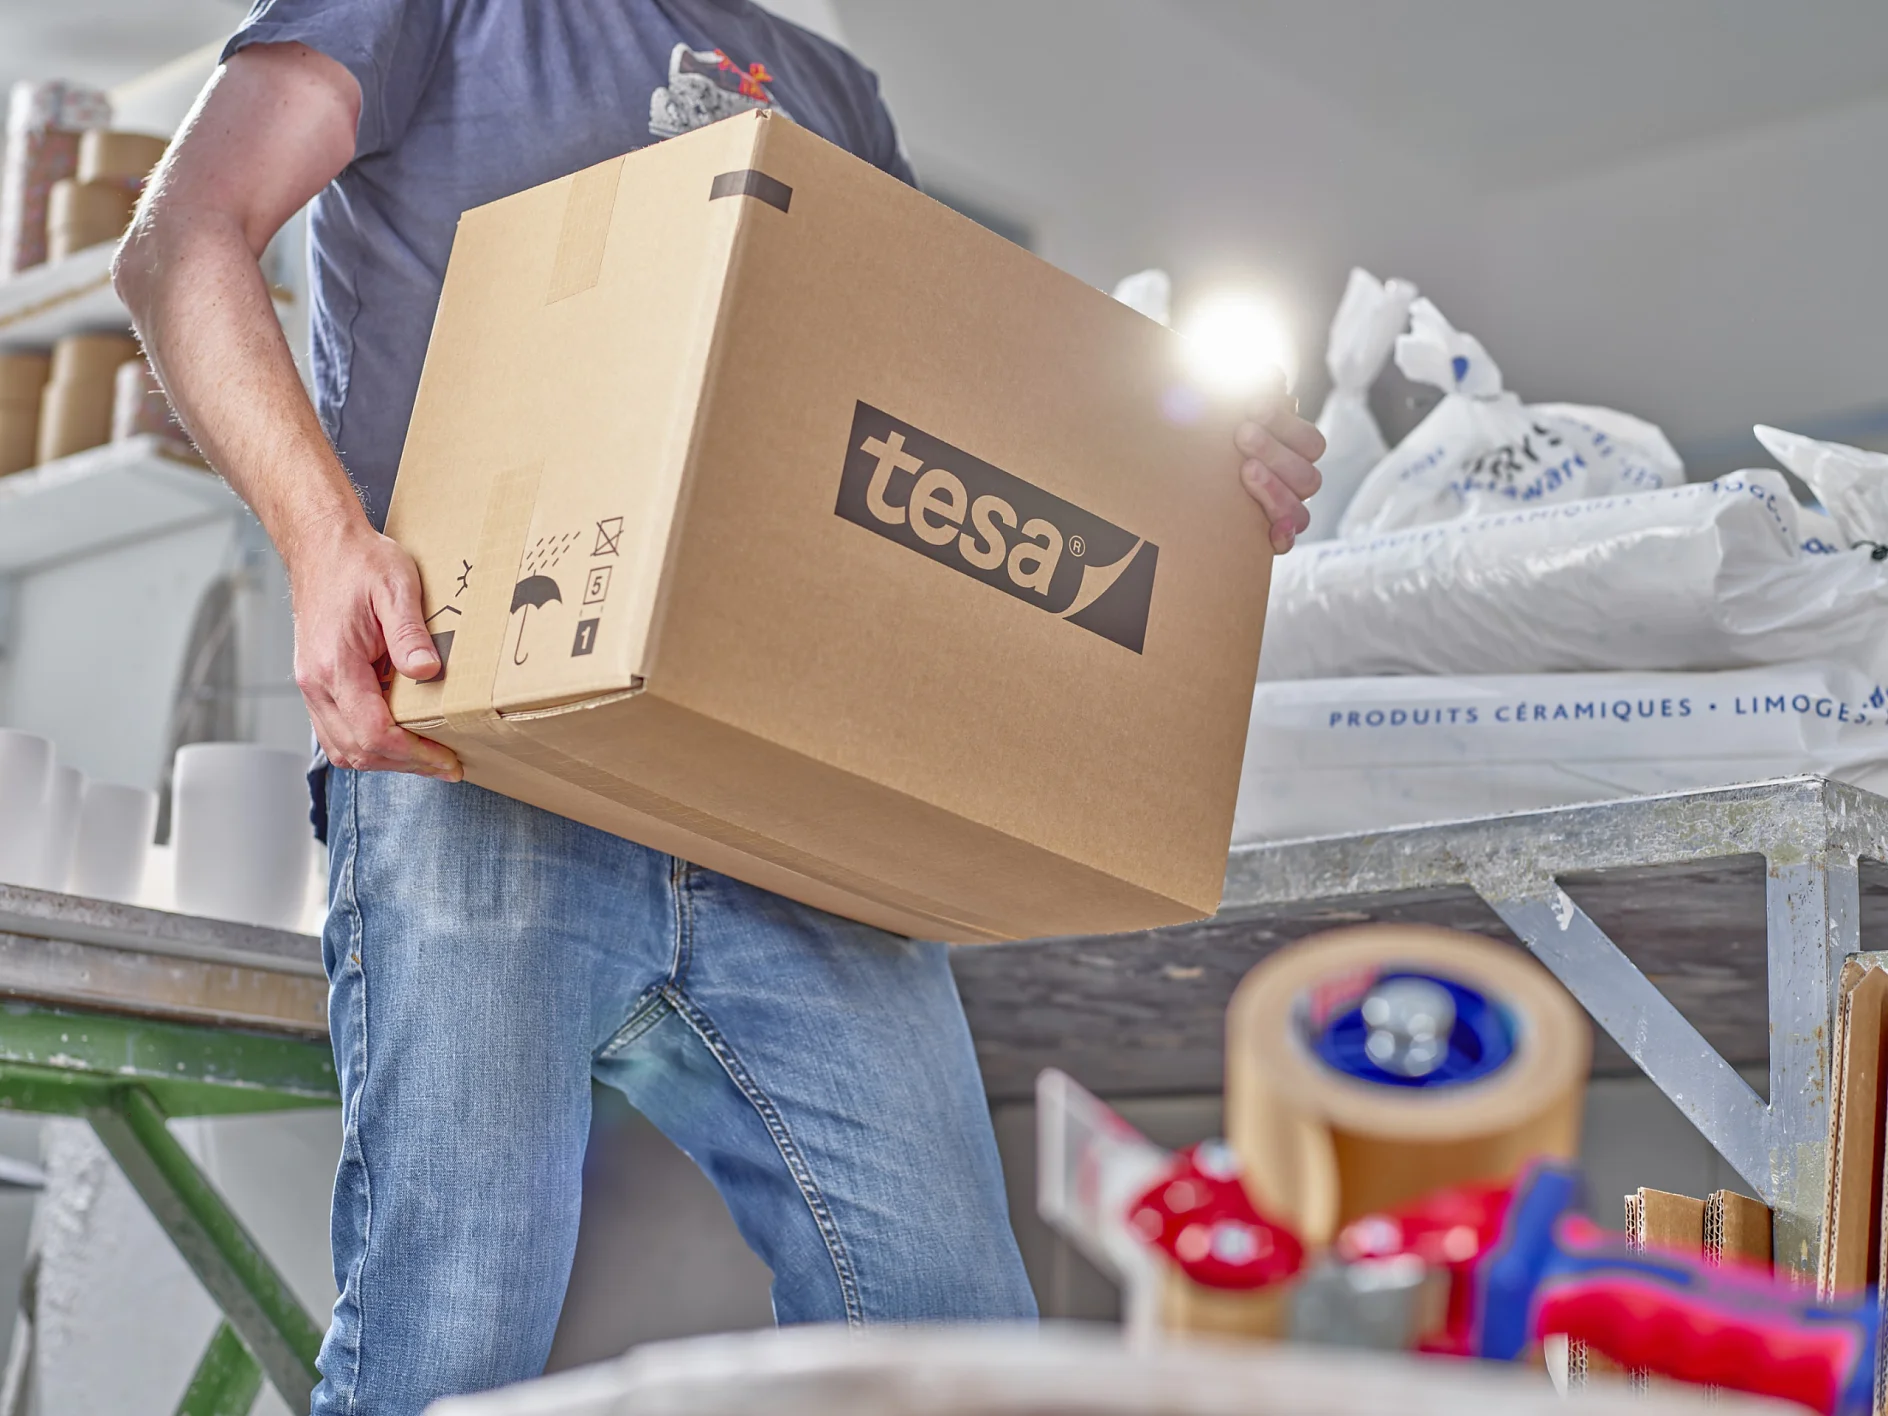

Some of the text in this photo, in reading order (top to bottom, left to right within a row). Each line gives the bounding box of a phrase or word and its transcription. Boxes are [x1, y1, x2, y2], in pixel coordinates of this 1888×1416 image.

[590, 575, 603, 596] 5
[580, 626, 592, 650] 1
[1329, 706, 1479, 728] PRODUITS
[1494, 697, 1693, 723] CÉRAMIQUES
